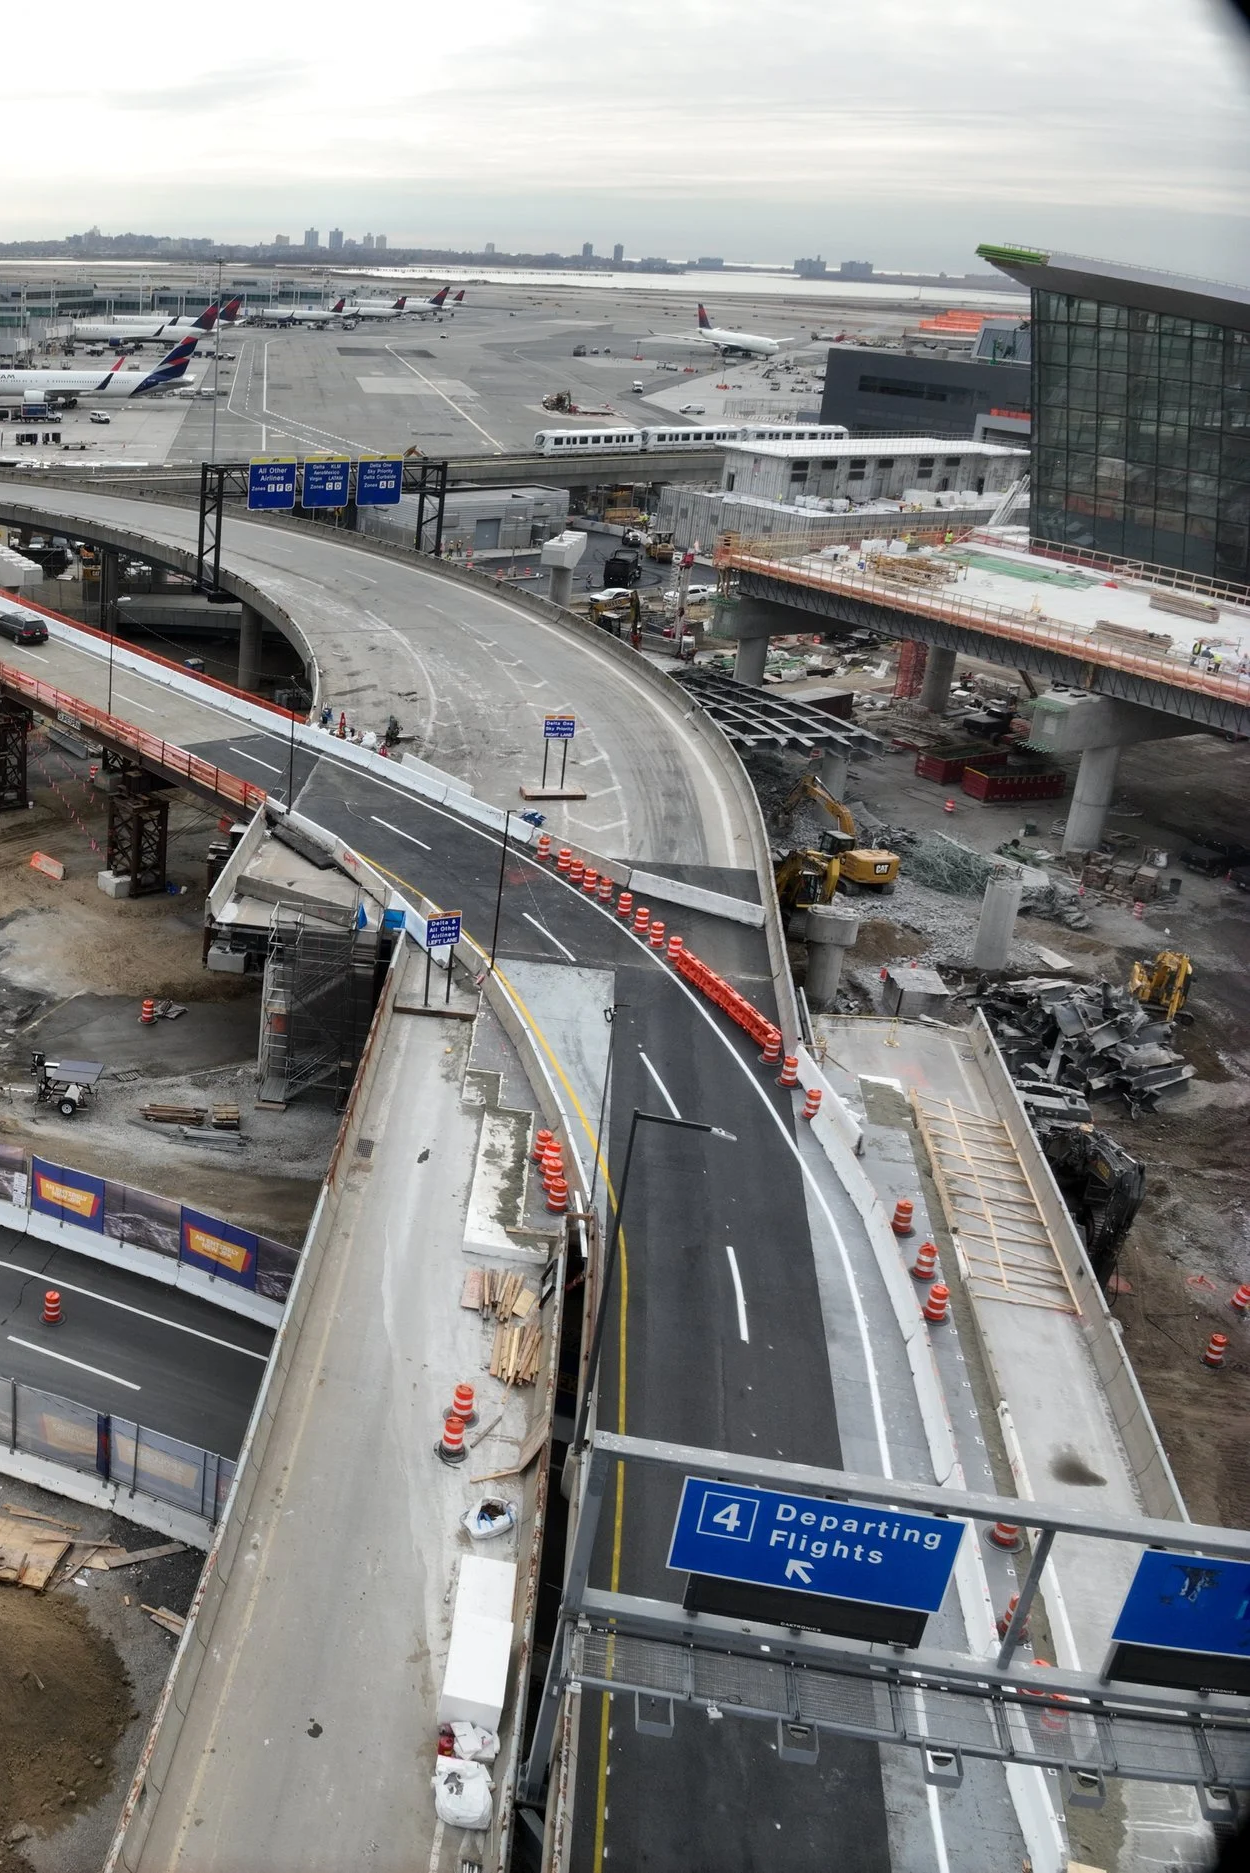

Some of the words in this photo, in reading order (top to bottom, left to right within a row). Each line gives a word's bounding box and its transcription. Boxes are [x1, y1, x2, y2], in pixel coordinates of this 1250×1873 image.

[876, 865, 889, 874] CAT
[712, 1503, 741, 1532] 4
[775, 1503, 943, 1550] Departing
[769, 1529, 884, 1565] Flights
[780, 1621, 821, 1632] DAKTRONICS
